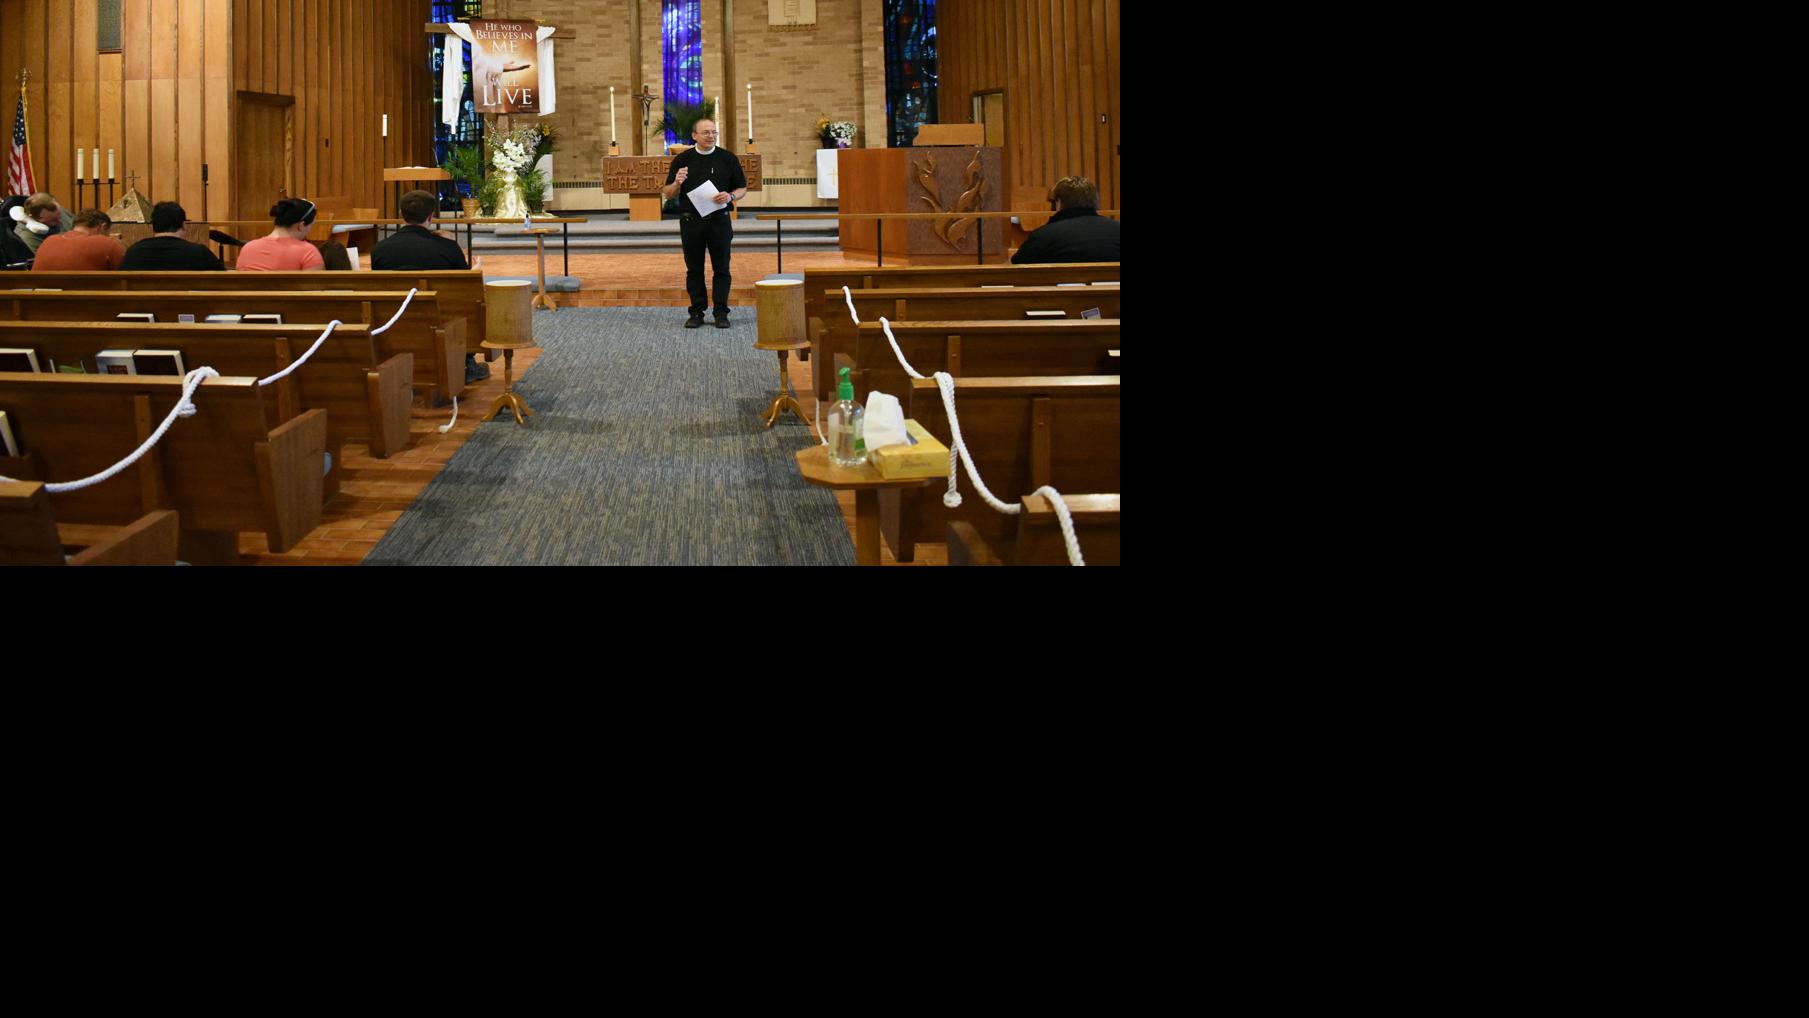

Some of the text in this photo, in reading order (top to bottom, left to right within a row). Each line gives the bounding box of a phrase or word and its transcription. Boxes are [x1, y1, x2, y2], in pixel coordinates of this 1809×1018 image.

[485, 23, 497, 31] HE
[476, 30, 519, 40] BELIEVES
[493, 41, 517, 53] ME
[483, 86, 532, 106] LIVE
[639, 160, 670, 174] THE
[739, 159, 758, 172] HE
[607, 176, 639, 190] THE
